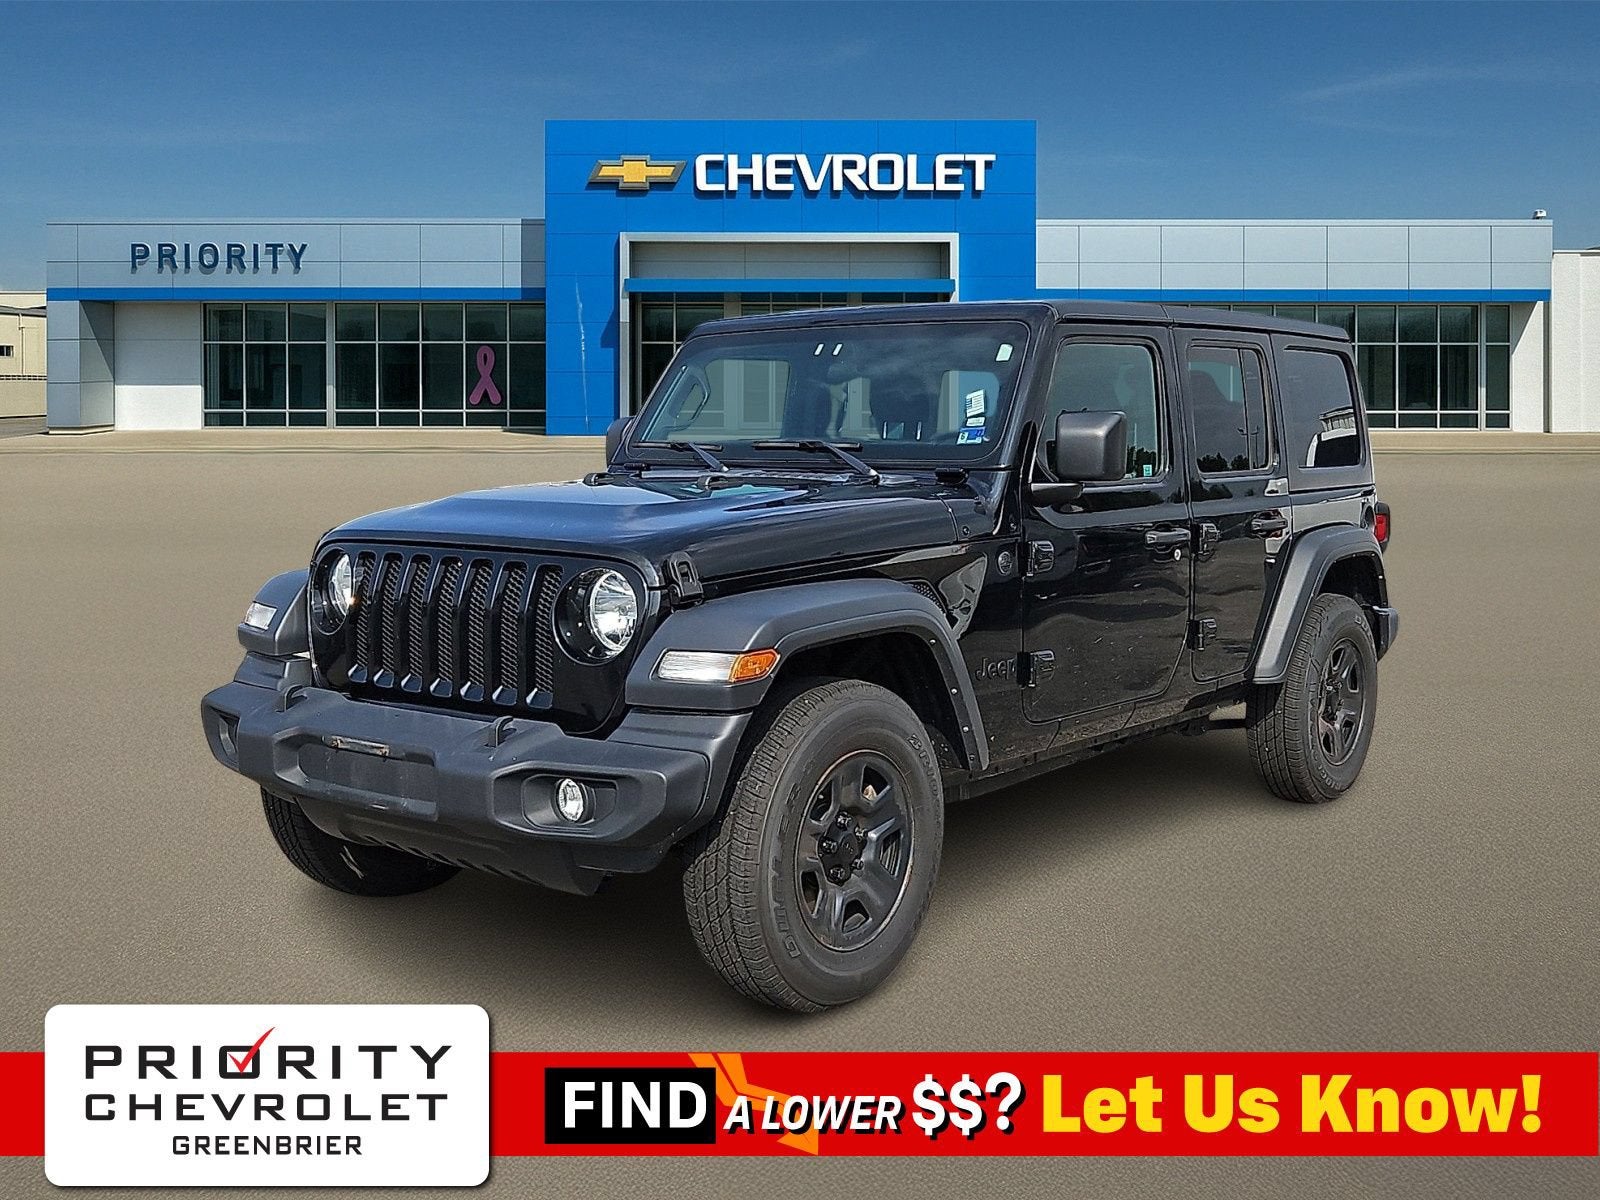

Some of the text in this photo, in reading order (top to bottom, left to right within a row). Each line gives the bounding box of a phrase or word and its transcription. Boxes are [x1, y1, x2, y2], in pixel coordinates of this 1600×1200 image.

[694, 153, 996, 192] CHEVROLET
[130, 243, 308, 271] PRIORITY
[975, 657, 1018, 681] Jeep
